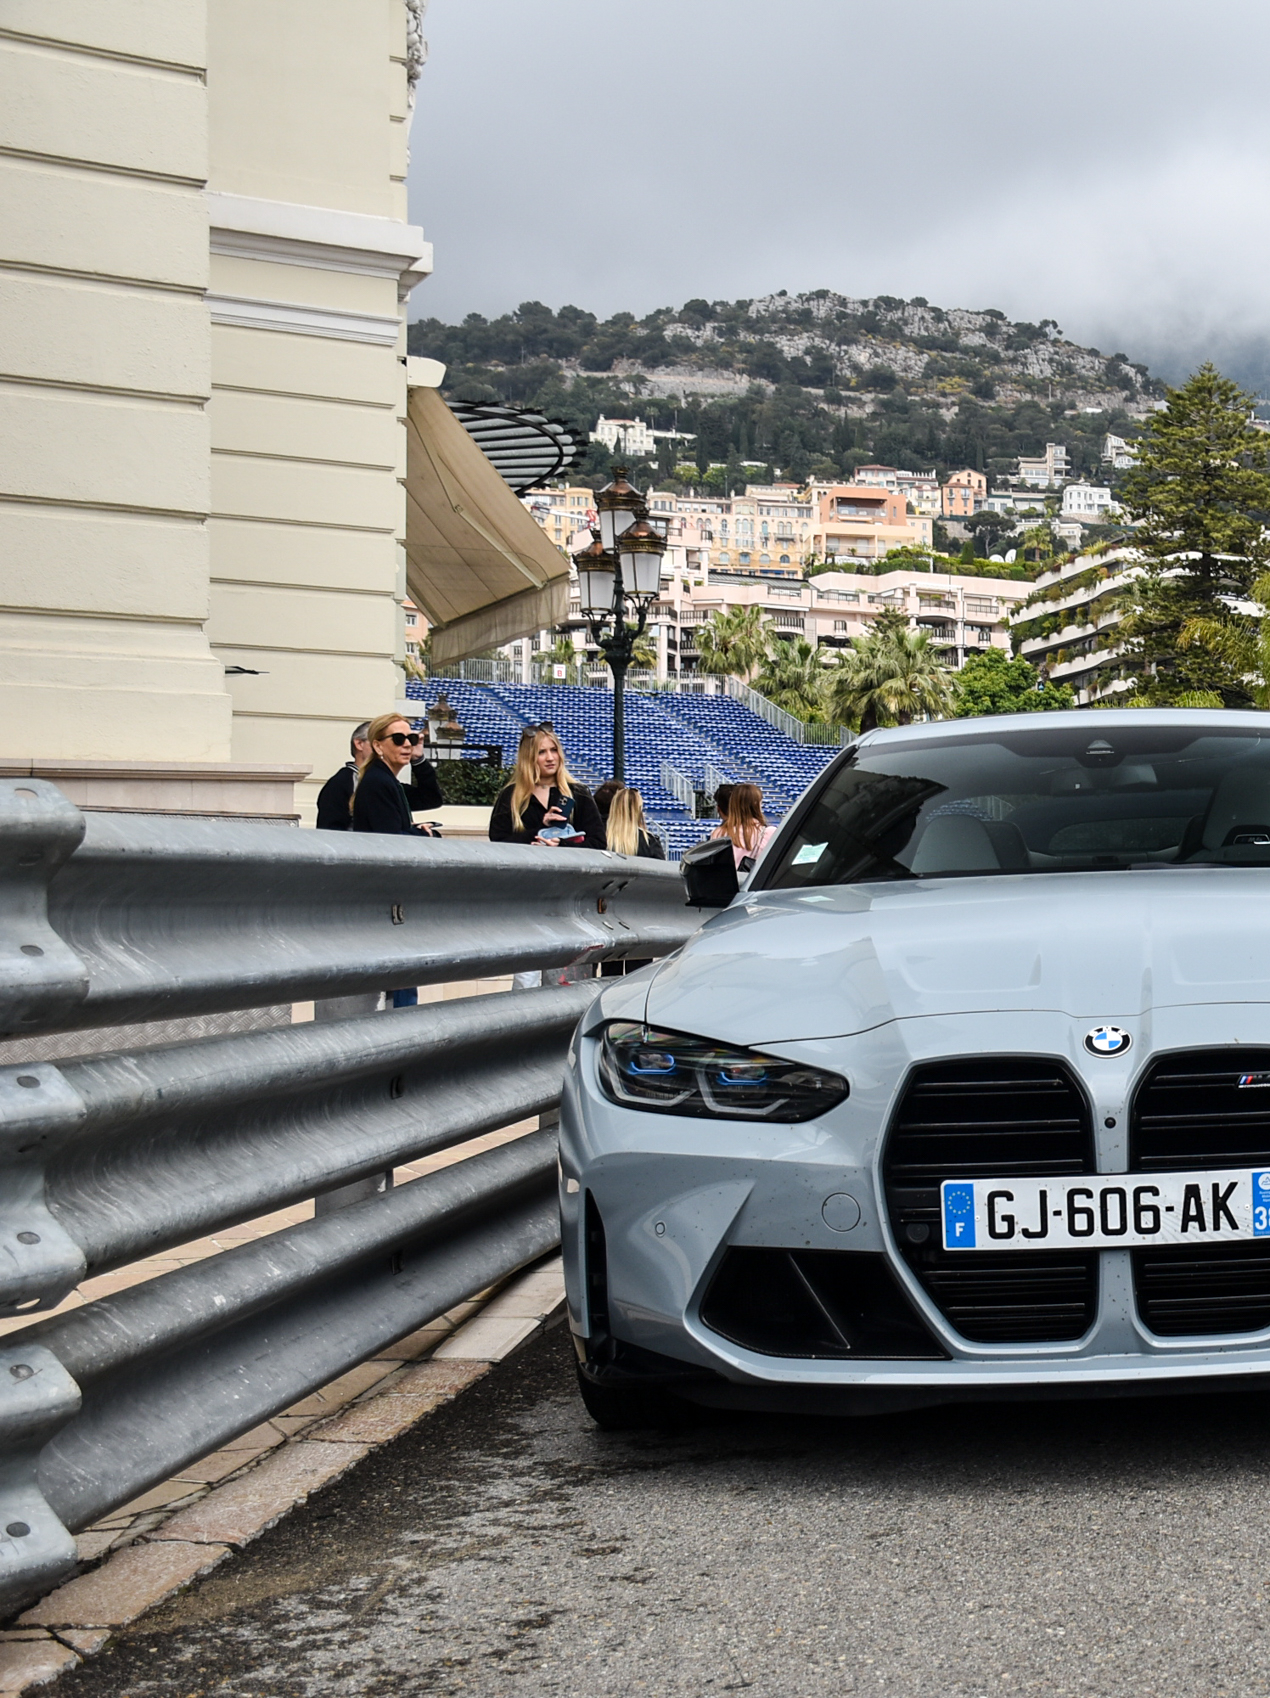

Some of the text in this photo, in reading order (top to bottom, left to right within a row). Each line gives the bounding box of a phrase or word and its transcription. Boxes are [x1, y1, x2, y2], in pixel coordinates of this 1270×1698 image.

[1088, 1026, 1128, 1038] BMW
[986, 1181, 1239, 1240] GJ-606-AK
[955, 1222, 965, 1237] F
